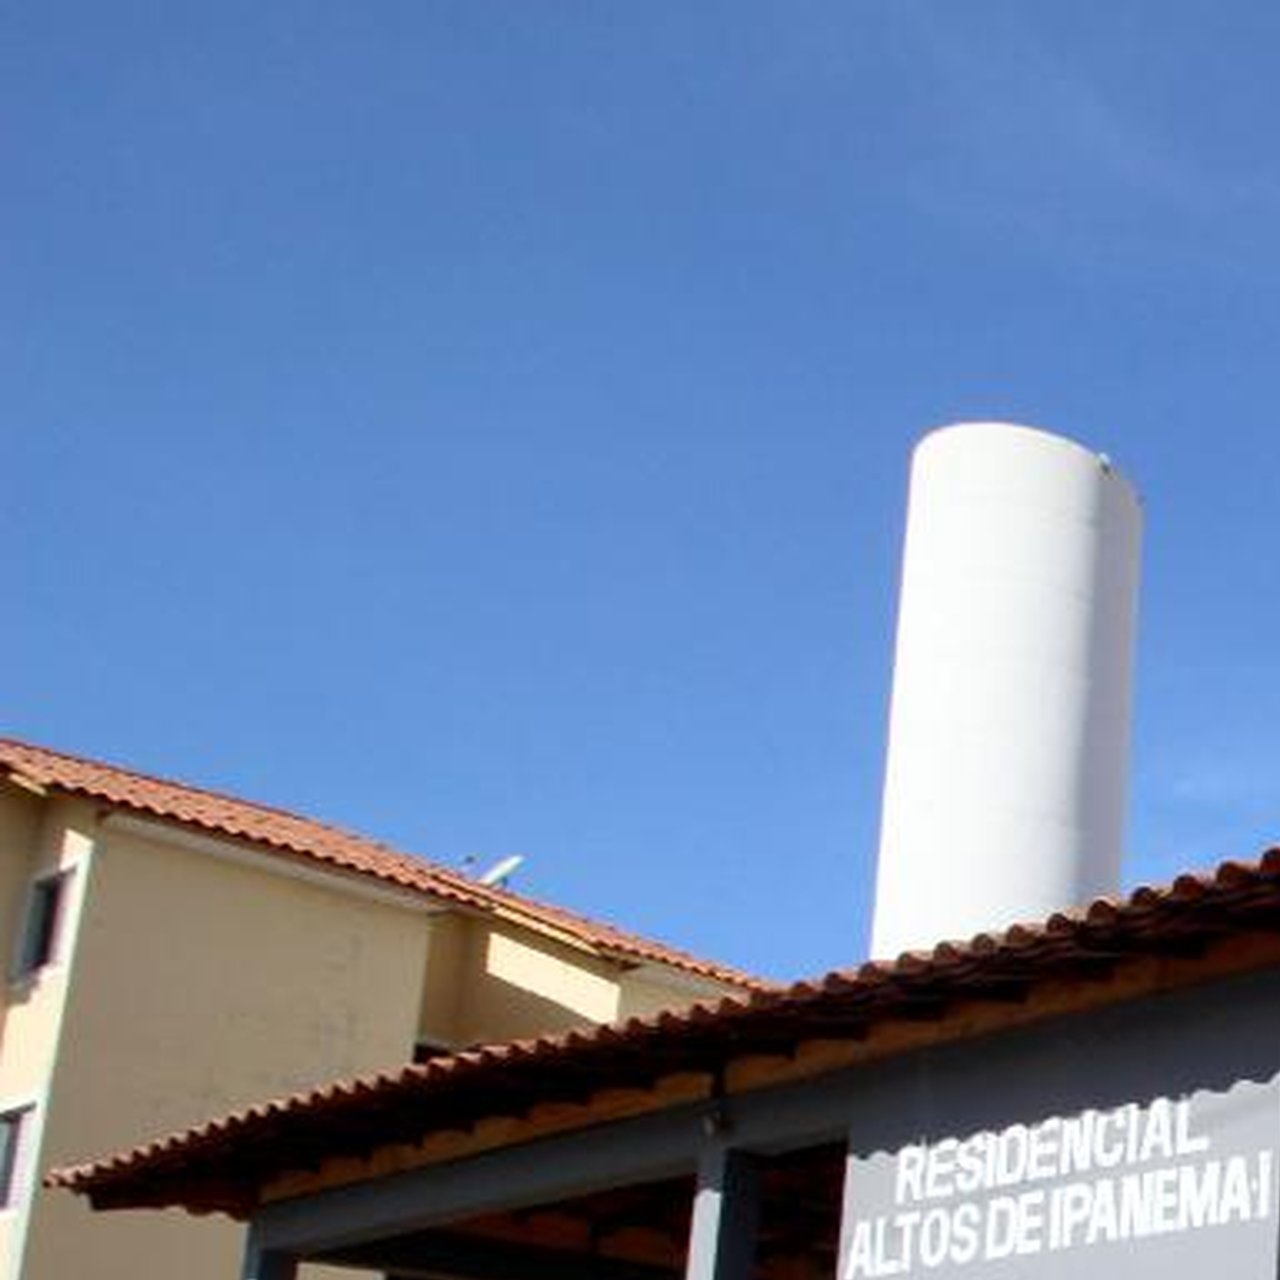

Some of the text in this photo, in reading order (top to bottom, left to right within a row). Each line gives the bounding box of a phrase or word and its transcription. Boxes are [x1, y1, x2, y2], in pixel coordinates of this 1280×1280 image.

[895, 1098, 1209, 1205] RESIDENCIAL
[843, 1204, 981, 1280] ALTOS
[985, 1189, 1045, 1261] DE
